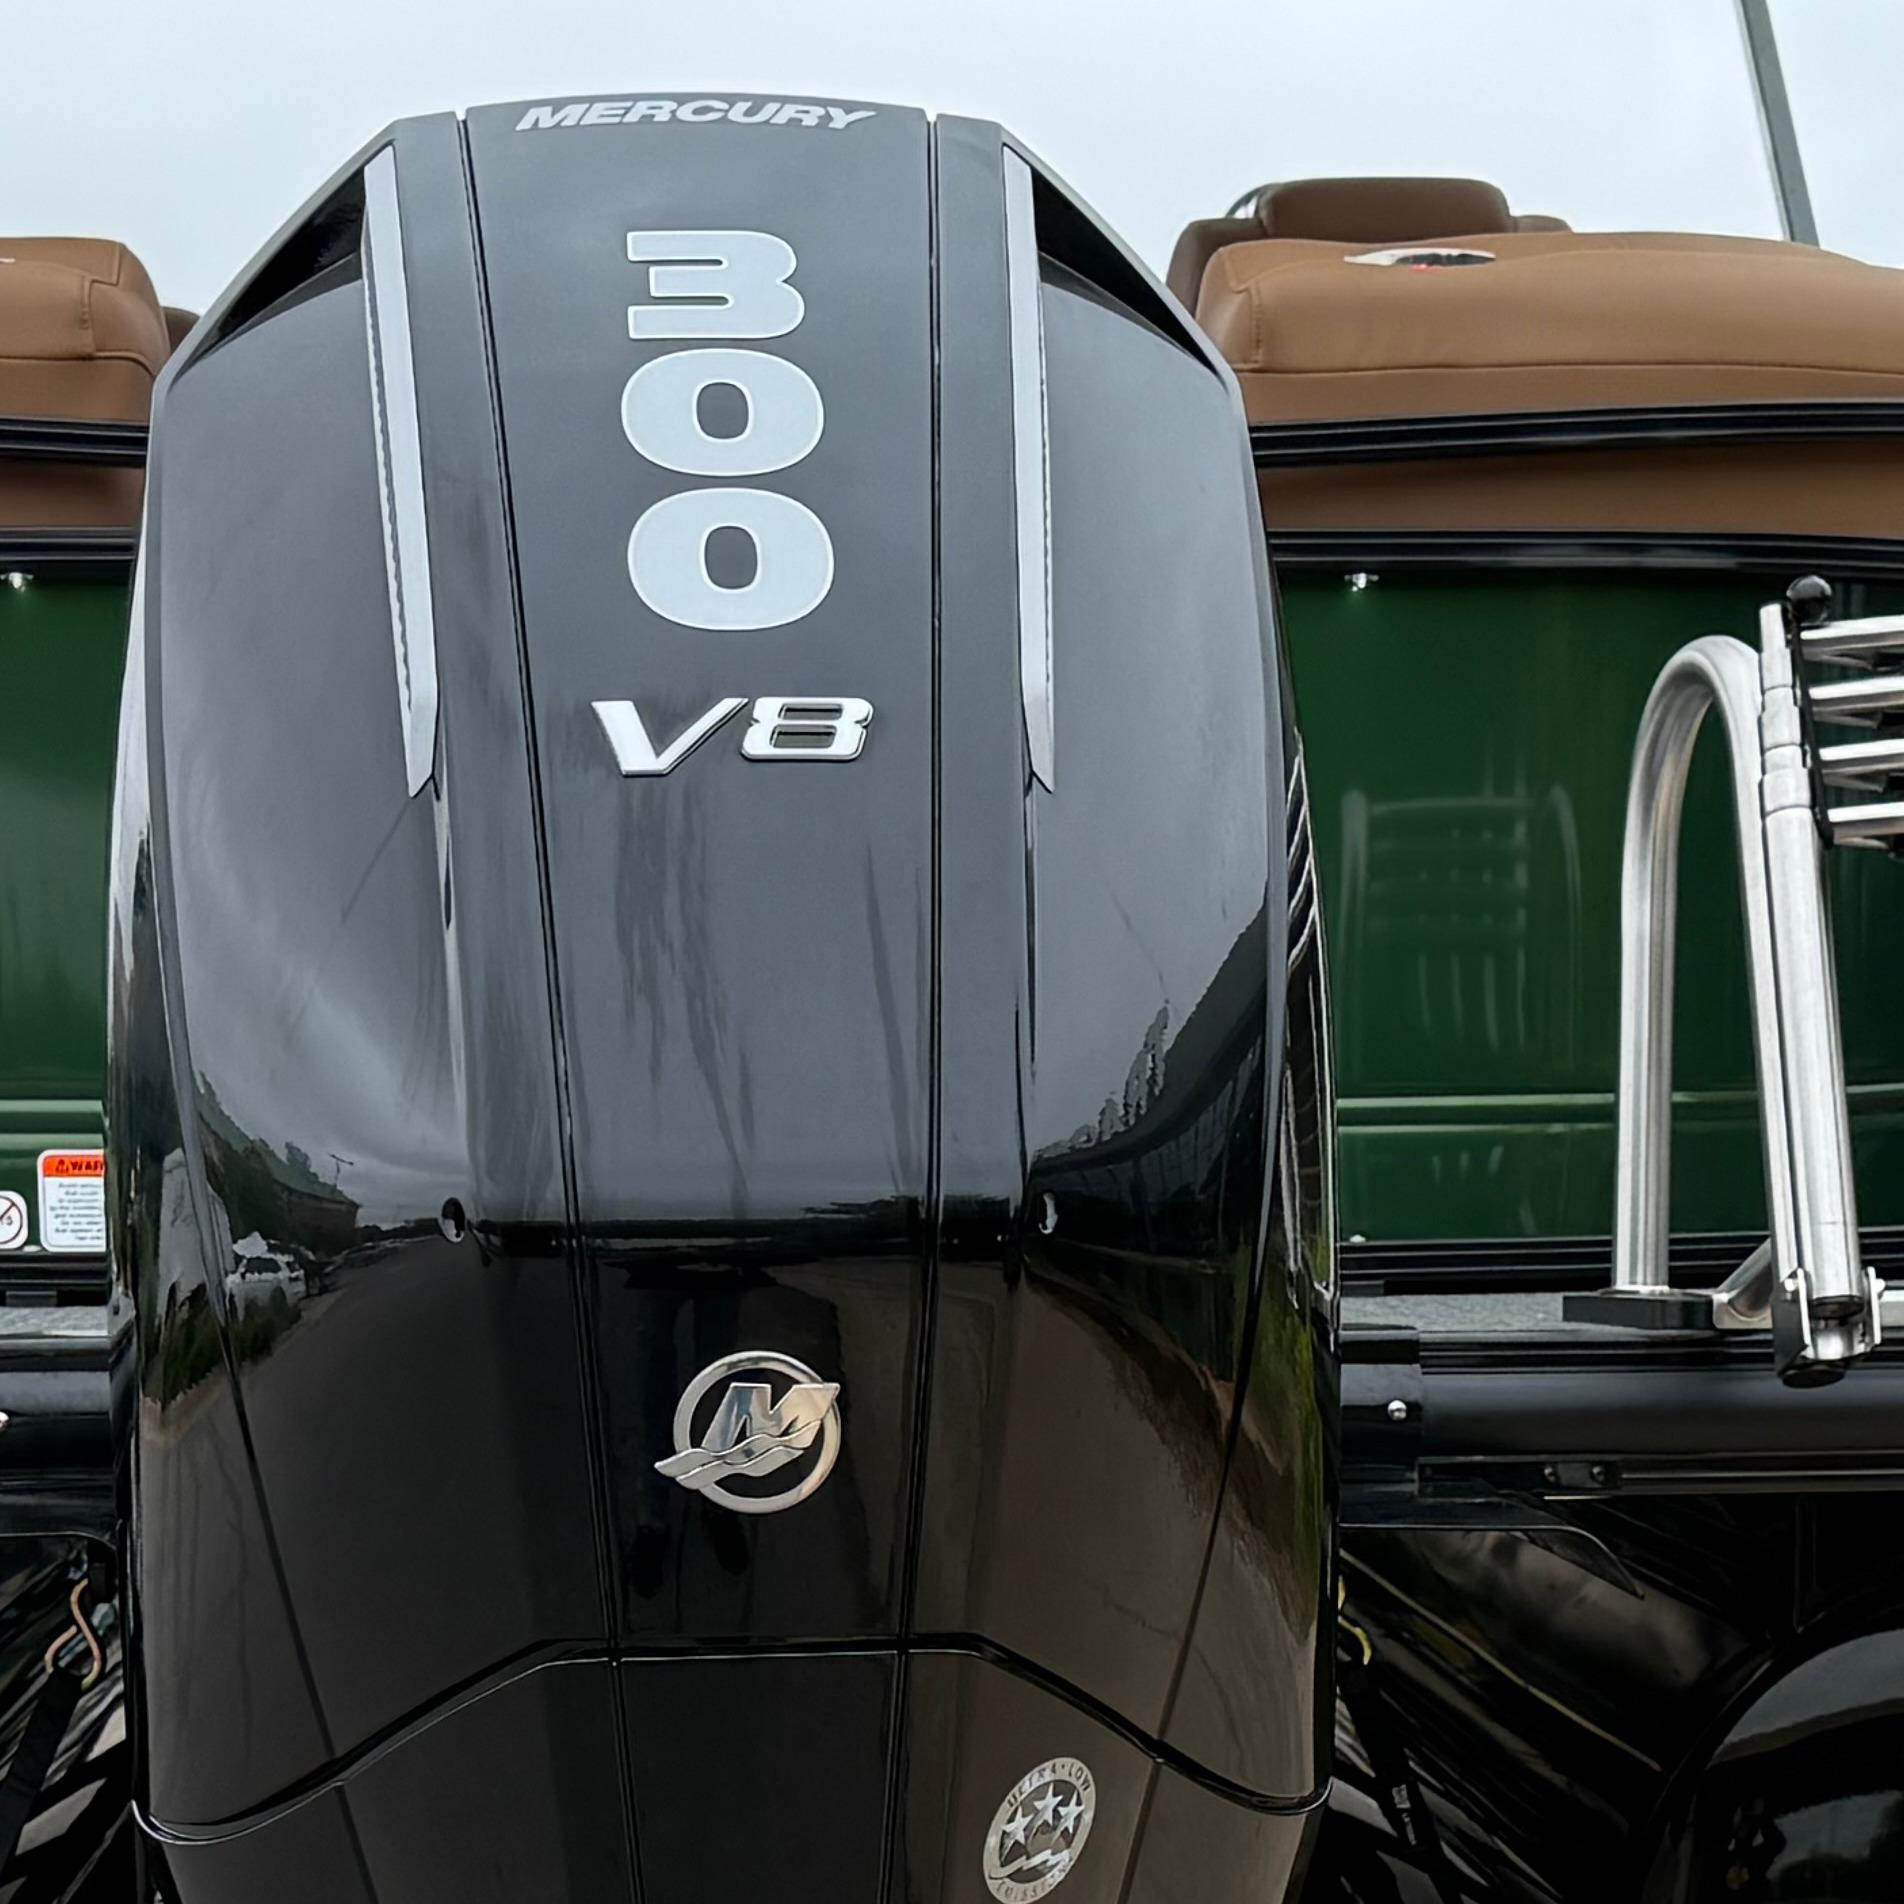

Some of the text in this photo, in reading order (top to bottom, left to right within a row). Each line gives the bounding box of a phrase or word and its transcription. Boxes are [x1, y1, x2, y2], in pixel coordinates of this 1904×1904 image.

[514, 99, 879, 131] MERCURY
[620, 229, 835, 631] 300
[590, 696, 877, 778] V8
[1068, 1763, 1090, 1791] LOW
